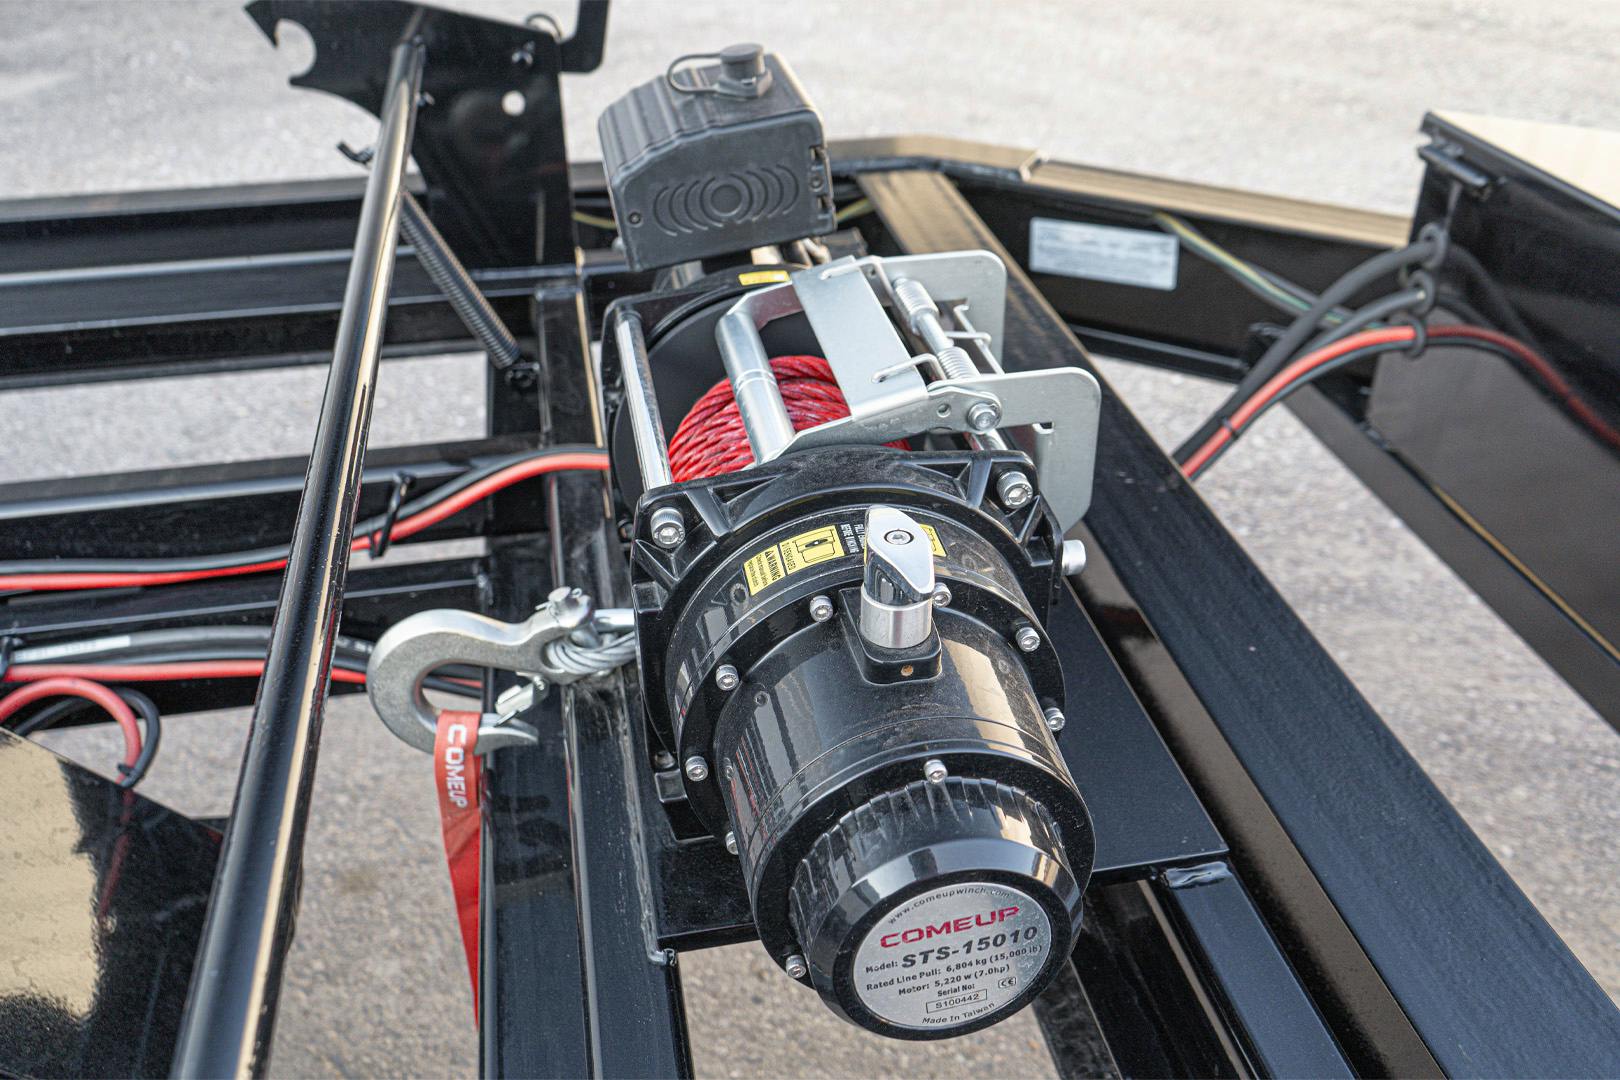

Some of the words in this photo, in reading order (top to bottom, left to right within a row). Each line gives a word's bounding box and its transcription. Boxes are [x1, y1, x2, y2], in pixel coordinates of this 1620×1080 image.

[444, 723, 468, 808] COMEUP
[888, 887, 1012, 924] www.comeupwinch.com
[880, 906, 1020, 948] COMEUP
[866, 960, 898, 974] Model:
[902, 926, 1038, 968] STS-15010
[866, 978, 894, 991] Rated
[896, 974, 918, 986] Line
[919, 968, 941, 981] Pull:
[946, 960, 974, 973] 6,804
[975, 958, 988, 968] kg
[990, 947, 1026, 965] (15,000
[898, 984, 930, 996] Motor:
[934, 974, 962, 988] 5,220
[974, 964, 1010, 980] (7.0hp)
[935, 994, 980, 1009] S100442
[938, 986, 960, 997] Serial
[962, 984, 975, 993] No:
[922, 1016, 947, 1024] Made
[962, 1002, 994, 1018] Taiwan
